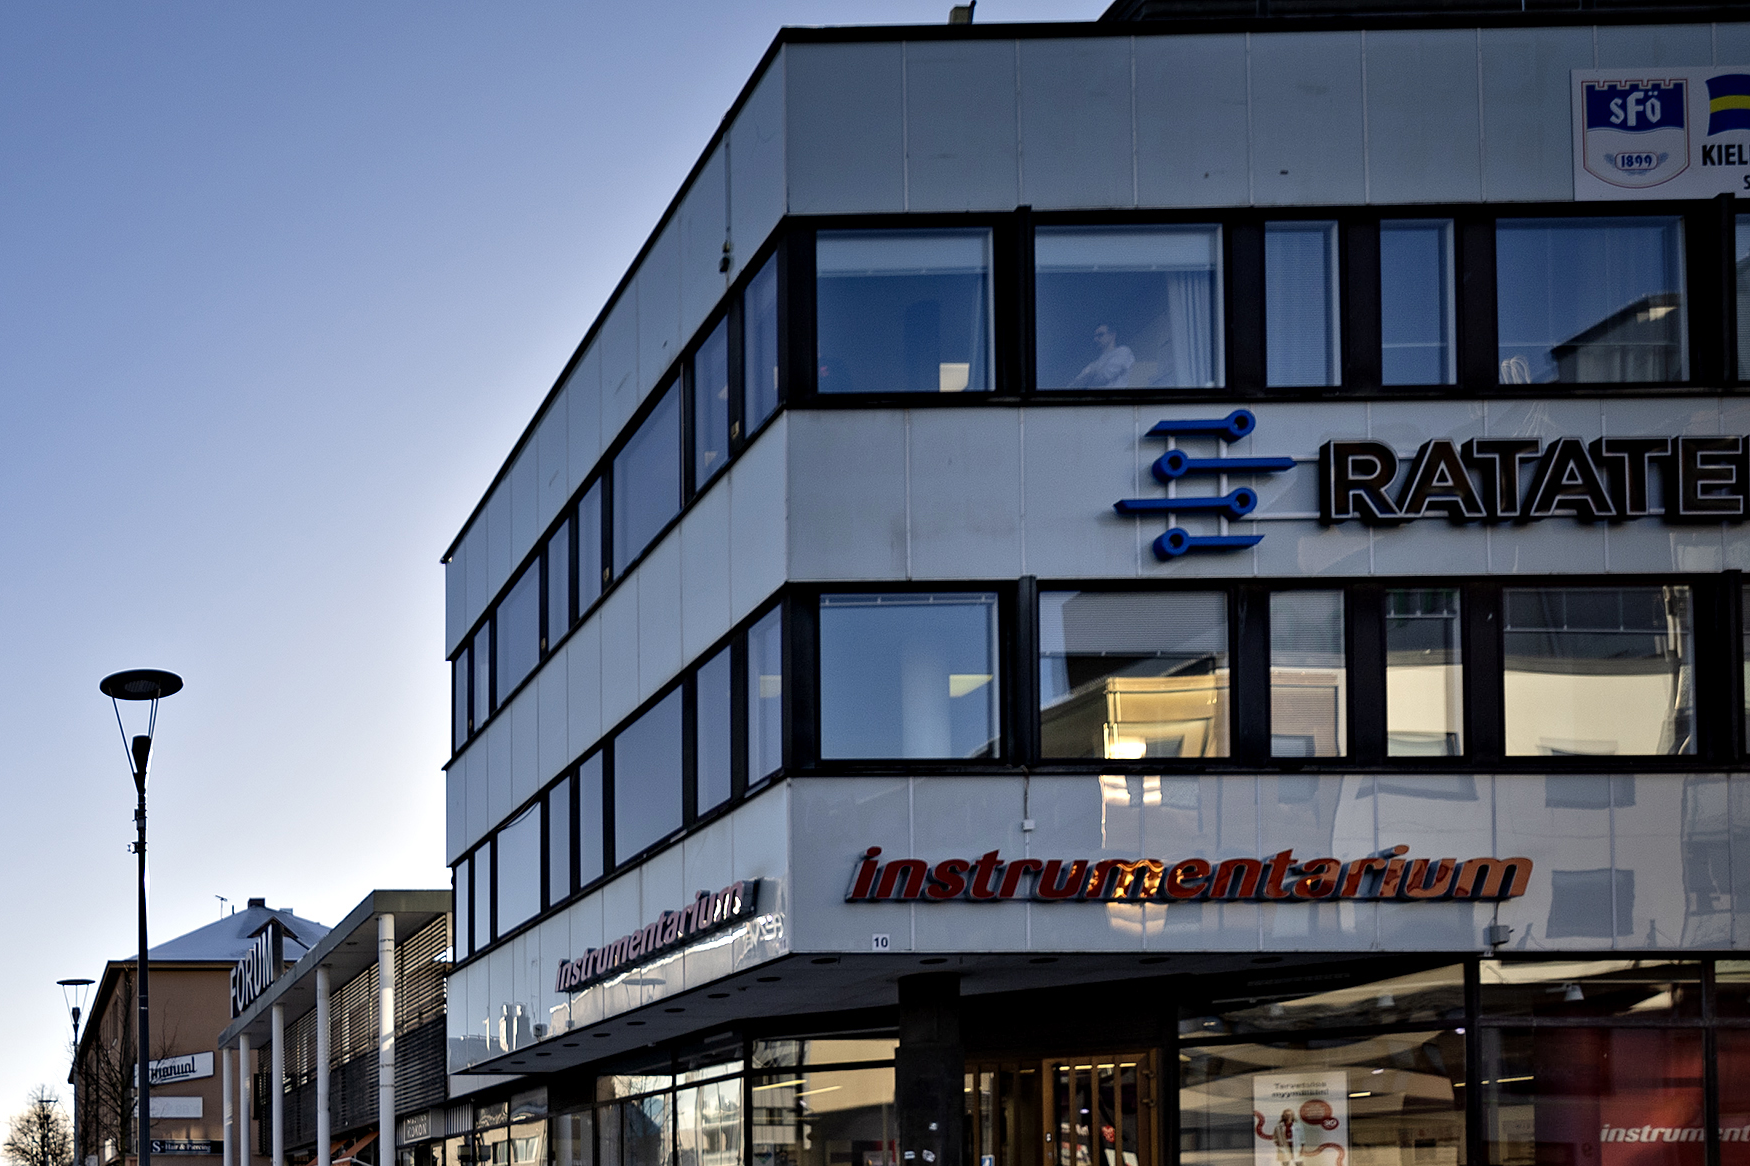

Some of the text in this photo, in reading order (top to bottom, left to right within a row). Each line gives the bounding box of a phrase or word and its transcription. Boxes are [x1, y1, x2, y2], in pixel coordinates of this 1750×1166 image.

[1620, 154, 1653, 168] 1899
[1701, 144, 1750, 167] KIEL
[851, 844, 1535, 900] instrumentarium
[555, 880, 746, 993] instrumentarium
[874, 937, 888, 948] 10
[230, 924, 274, 1019] FORUM
[1600, 1124, 1750, 1142] instrumnt
